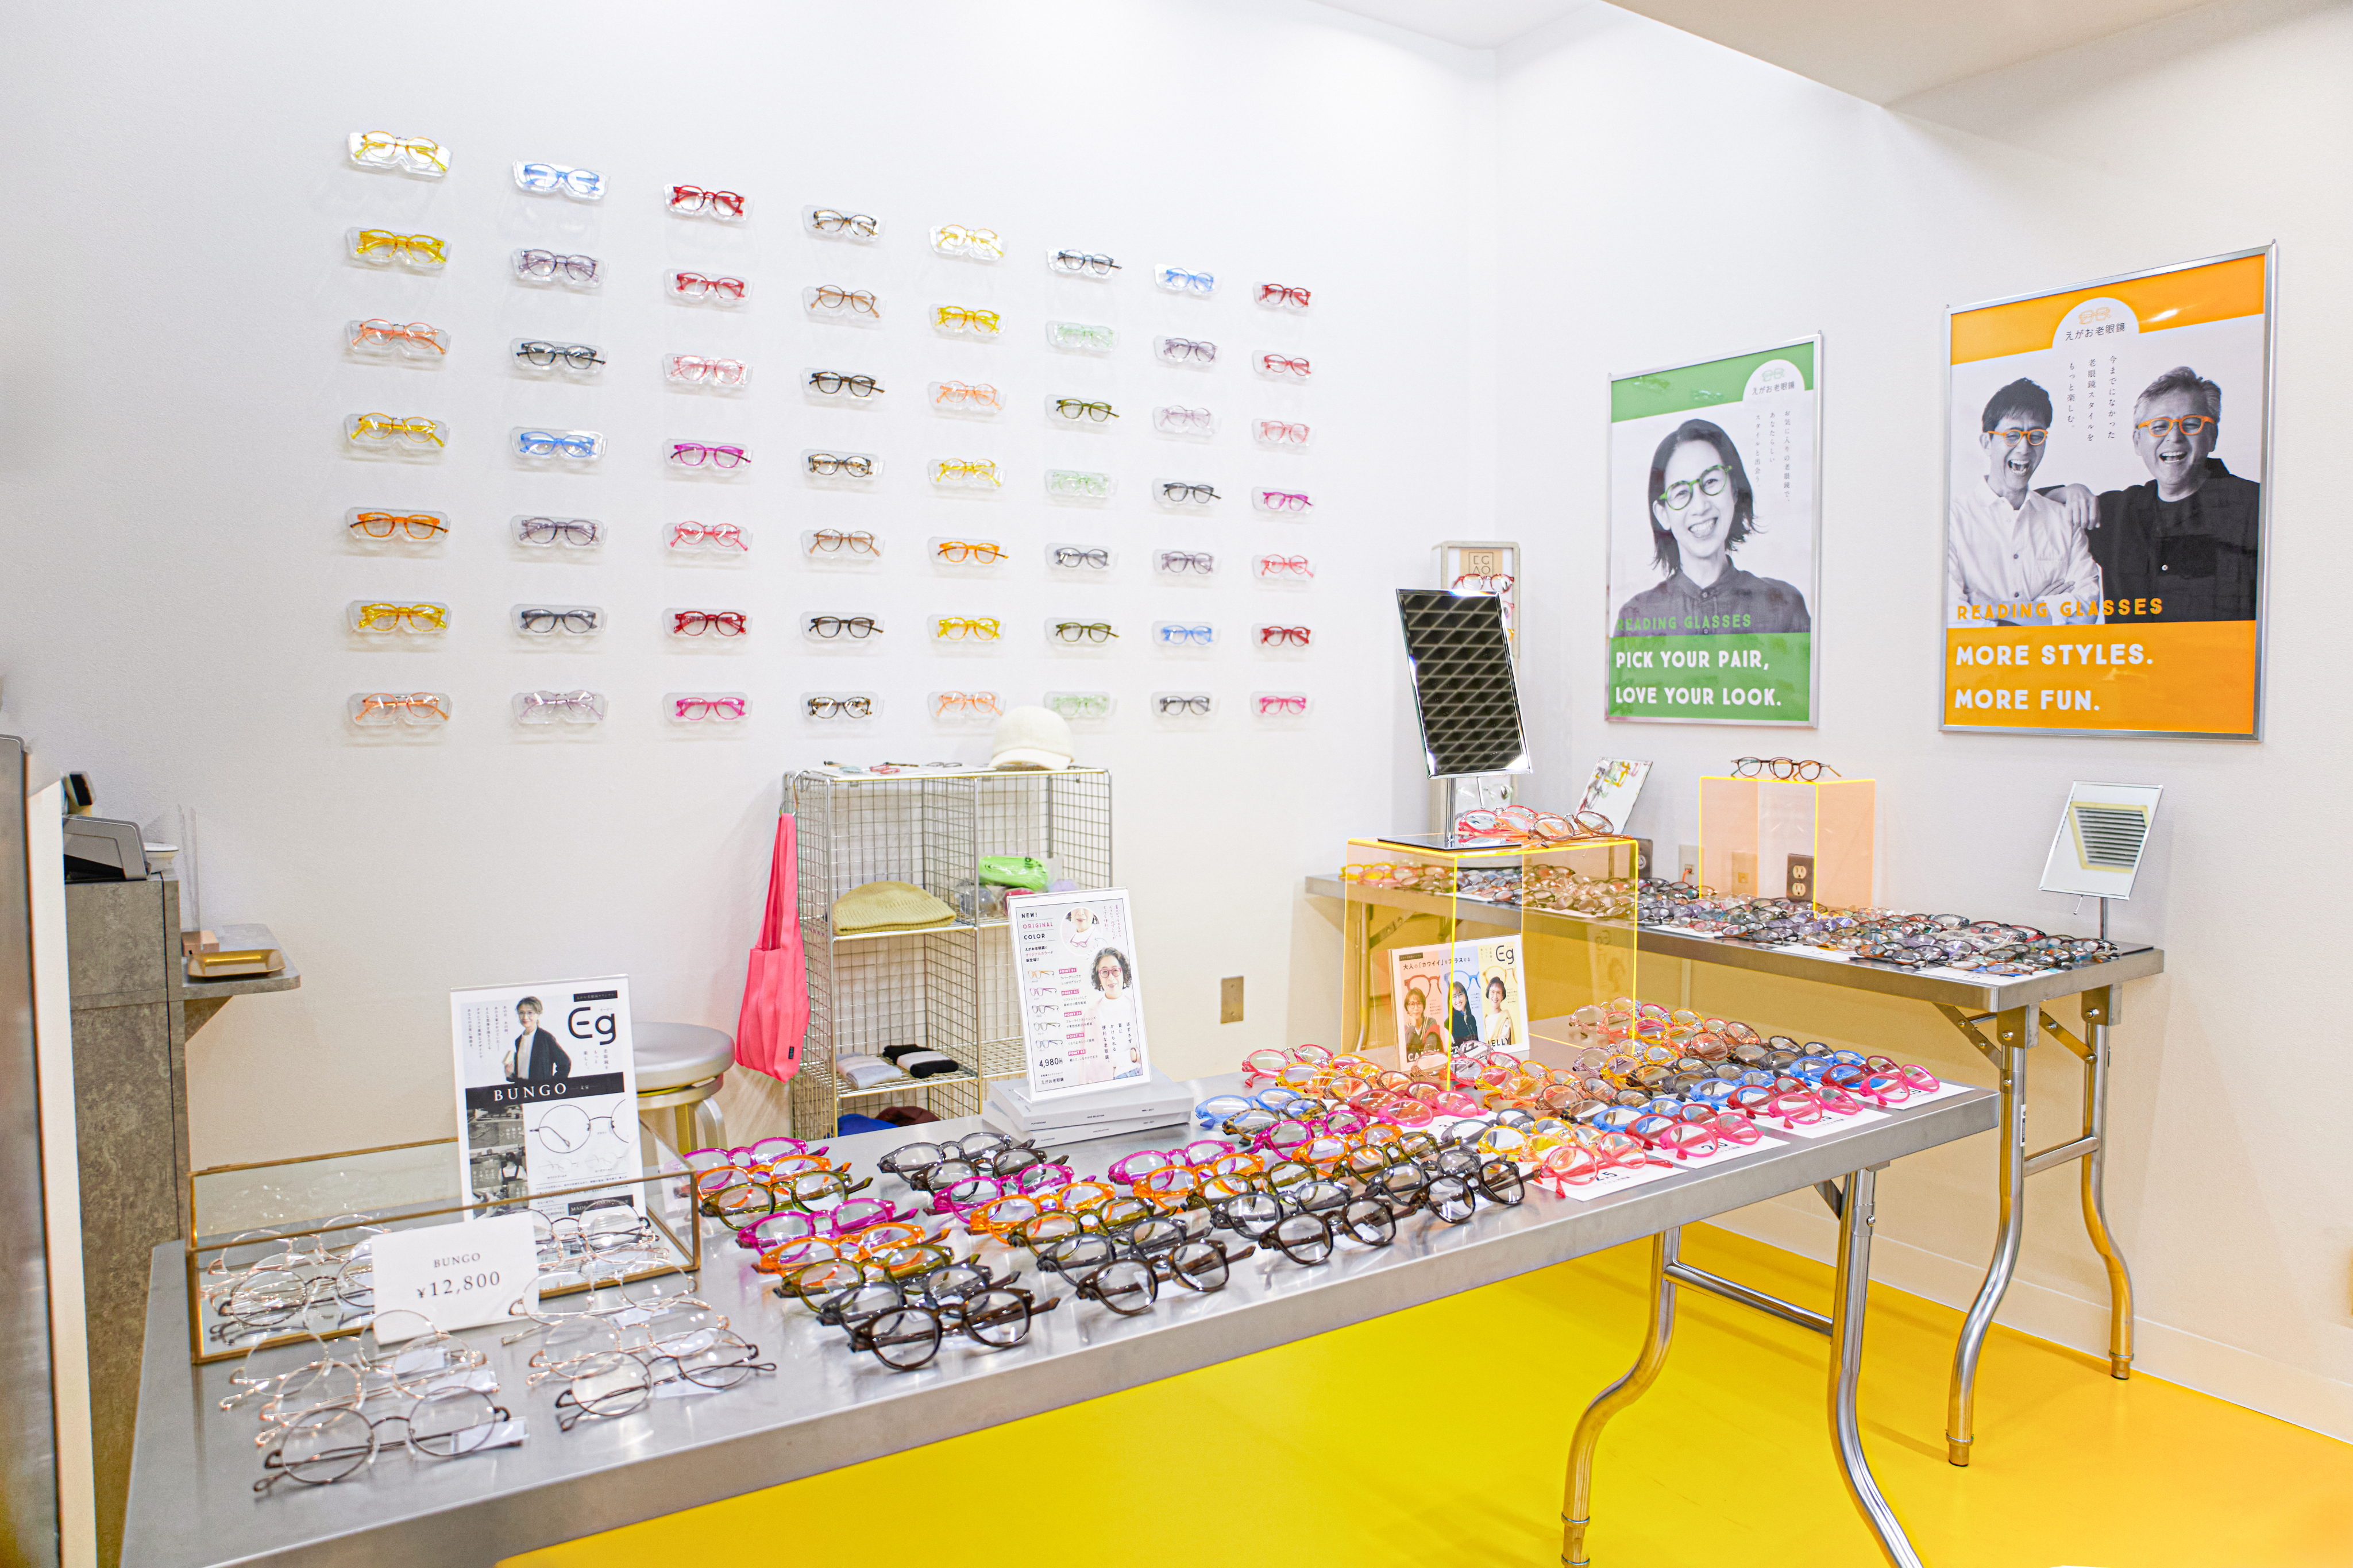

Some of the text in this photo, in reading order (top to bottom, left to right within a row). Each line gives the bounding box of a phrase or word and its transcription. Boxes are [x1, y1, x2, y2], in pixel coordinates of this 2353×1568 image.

[2065, 322, 2126, 341] えがお老眼鏡
[1752, 381, 1795, 395] えがお老眼鏡
[2067, 362, 2075, 427] もっと楽しむ。
[2108, 355, 2117, 439] 今までになかった
[2087, 358, 2096, 441] 老眼鏡スタイルを
[1957, 598, 2162, 620] READING GLASSES
[1617, 613, 1751, 631] READING GLASSES
[1616, 650, 1769, 670] PICK YOUR PAIR,
[1955, 643, 2153, 666] MORE STYLES.
[1615, 687, 1781, 706] LOVE YOUR LOOK.
[1955, 689, 2100, 710] MORE FUN.
[1496, 945, 1514, 965] Eg
[568, 1006, 616, 1045] Eg
[493, 1083, 566, 1101] BUNGO
[434, 1253, 480, 1268] BUNGO
[417, 1271, 500, 1298] ¥12,800
